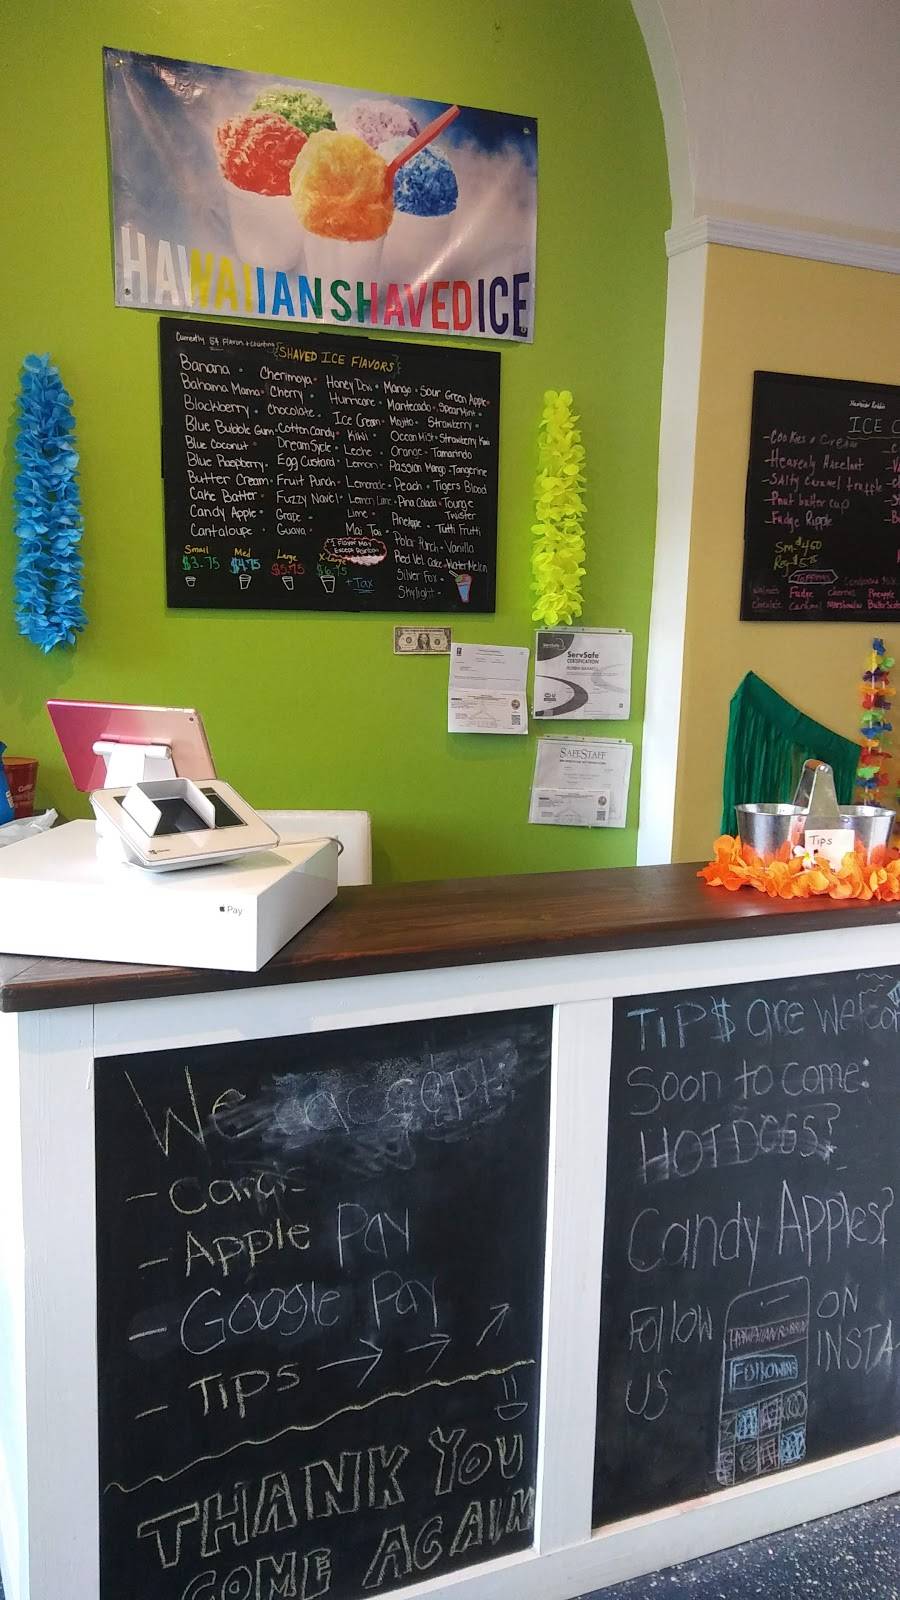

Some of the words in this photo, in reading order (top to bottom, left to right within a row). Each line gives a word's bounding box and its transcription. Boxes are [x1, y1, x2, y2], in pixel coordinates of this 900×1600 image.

[278, 346, 317, 362] SHAVED
[321, 352, 345, 364] ICE
[180, 353, 230, 375] Banana
[260, 366, 312, 388] Cherimoya
[180, 373, 228, 393] Bahama
[231, 381, 260, 397] Mama
[326, 375, 354, 395] Honey
[384, 381, 412, 396] Mango
[420, 385, 441, 397] Sour
[270, 386, 303, 405] Cherry
[184, 394, 250, 418] Blackberry
[267, 404, 315, 417] Chocolate
[185, 415, 211, 432] Blue
[254, 425, 275, 436] Gum
[333, 412, 352, 426] Ice
[356, 413, 381, 427] Cream
[427, 417, 472, 430] Strawberry
[848, 416, 883, 434] ICE
[185, 435, 207, 449] Blue
[210, 439, 248, 450] Coconut
[390, 431, 418, 442] Ocean
[439, 433, 477, 448] Strawberry
[344, 444, 373, 457] Leche
[390, 446, 423, 459] Orange
[430, 447, 472, 459] Tamarindo
[186, 452, 212, 467] Blue
[216, 454, 264, 473] Raspberry
[277, 453, 298, 471] Egg
[300, 456, 336, 468] Custard
[346, 458, 378, 469] Lemon
[389, 460, 422, 473] Passion
[424, 462, 446, 475] Mango
[187, 470, 230, 484] Butter
[235, 473, 269, 486] Cream
[451, 464, 488, 478] Tangerine
[276, 474, 305, 486] Fruit
[309, 474, 336, 487] Punch
[346, 475, 386, 489] Lemonade
[393, 477, 423, 491] Peach
[433, 479, 460, 494] Tigers
[464, 480, 487, 495] Blood
[190, 486, 216, 501] Cake
[221, 489, 258, 503] Batter
[276, 490, 307, 508] Fuzzy
[311, 493, 340, 504] Navel
[348, 493, 375, 506] Lemon
[190, 504, 226, 521] Candy
[231, 506, 257, 522] Apple
[276, 508, 301, 522] Grape
[347, 510, 368, 518] Lime
[444, 511, 476, 520] Twister
[190, 523, 253, 538] Cantaloupe
[276, 523, 306, 536] Guava
[345, 522, 362, 536] Mai
[435, 524, 456, 534] Tutti
[459, 524, 481, 536] Frutti
[184, 545, 209, 554] Small
[234, 548, 251, 557] Med
[443, 540, 474, 553] Vanilla
[182, 556, 220, 571] $3.75
[394, 549, 411, 565] Red
[230, 558, 261, 574] $4.75
[396, 569, 420, 581] Silver
[424, 571, 437, 583] Fox
[808, 835, 832, 847] Tips
[627, 1066, 721, 1116] Soon
[735, 1060, 774, 1100] to
[124, 1065, 258, 1157] We
[628, 1201, 760, 1286] Candy
[817, 1285, 860, 1319] ON
[180, 1280, 342, 1356] Google
[625, 1369, 672, 1421] US
[137, 1446, 409, 1569] THANK
[428, 1426, 524, 1497] YOU
[180, 1548, 332, 1600] COME
[361, 1487, 536, 1589] AGAIN
